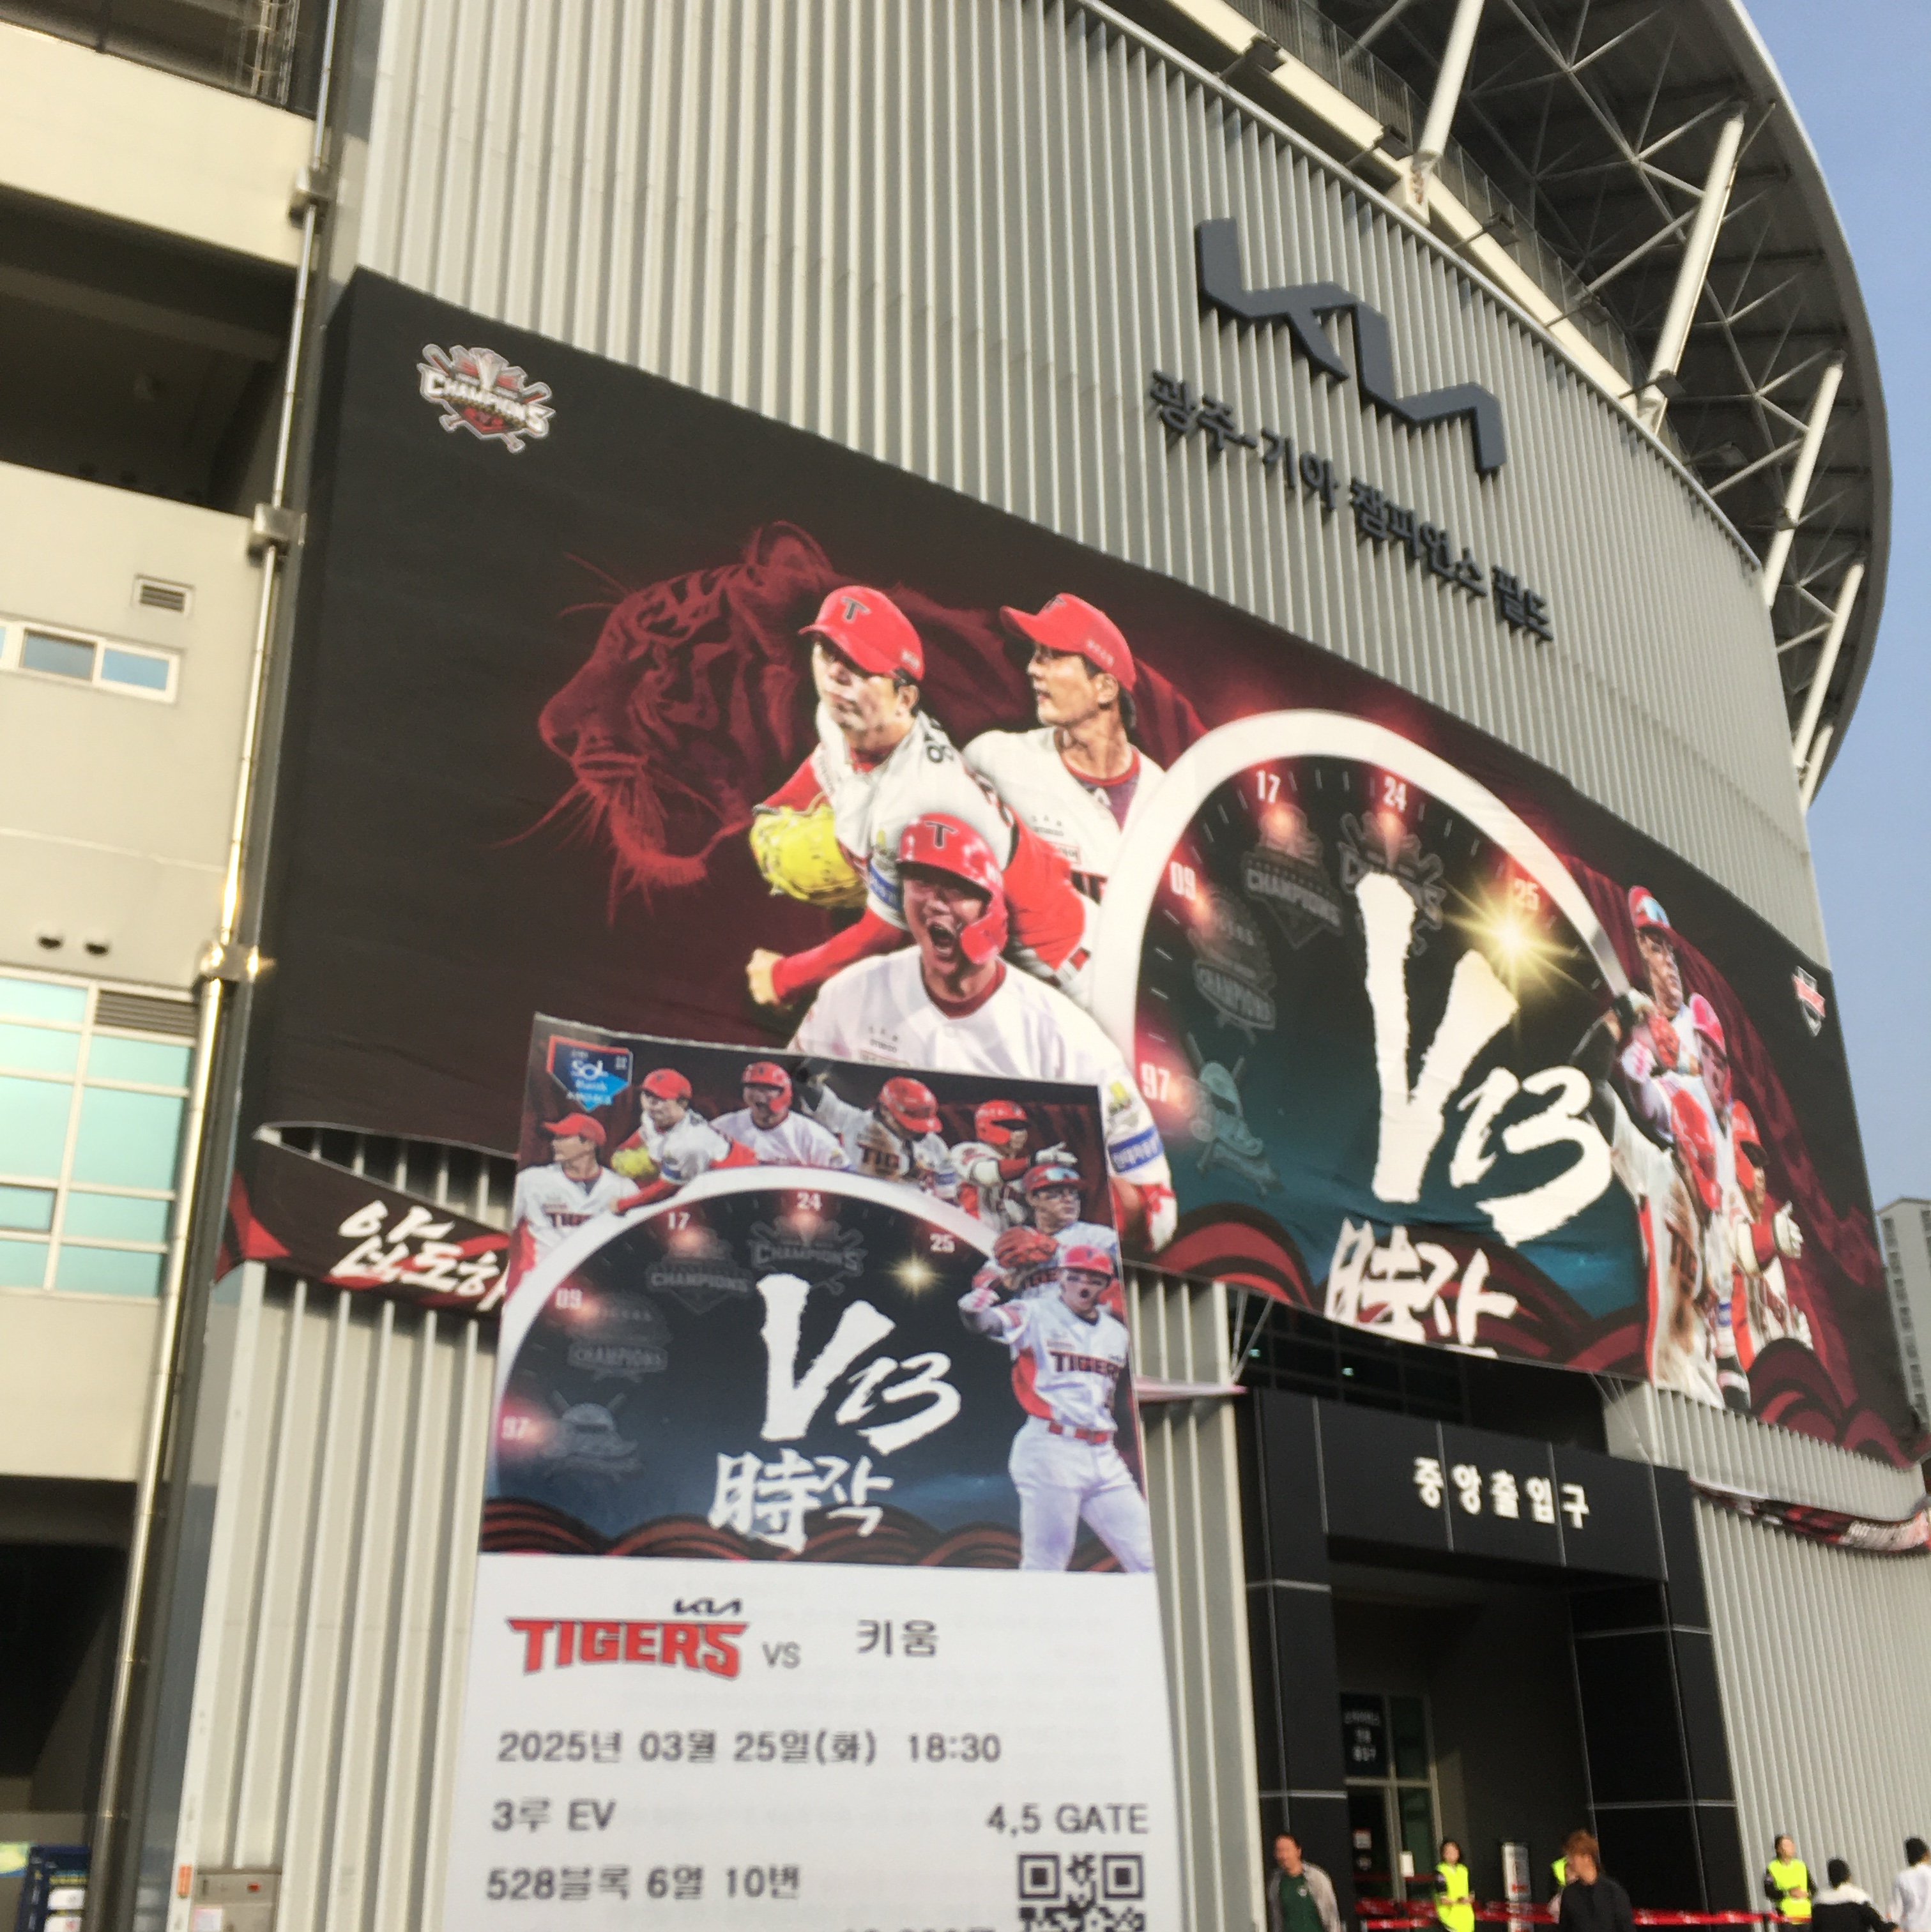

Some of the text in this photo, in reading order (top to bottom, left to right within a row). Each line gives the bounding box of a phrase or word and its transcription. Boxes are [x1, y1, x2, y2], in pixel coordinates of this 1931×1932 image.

[418, 365, 554, 434] CHAMPIONS
[1349, 476, 1487, 598] 챔피언스
[1491, 564, 1554, 642] 필드
[1256, 770, 1280, 803] 17
[1383, 775, 1408, 812] 24
[1170, 862, 1196, 901] 09
[1514, 878, 1541, 911] 25
[1355, 871, 1612, 1247] V13
[1141, 1062, 1170, 1102] 97
[797, 1192, 823, 1211] 24
[668, 1212, 691, 1230] 17
[930, 1234, 955, 1252] 25
[555, 1289, 582, 1309] 09
[756, 1274, 961, 1455] V13
[501, 1417, 530, 1440] 97
[708, 1449, 894, 1554] 時각
[505, 1617, 750, 1682] TIGERS
[856, 1619, 938, 1658] 키움
[497, 1728, 1002, 1765] 2025년 03월 25일(화) 18:30
[491, 1797, 616, 1832] 3루 EV
[986, 1802, 1149, 1837] 4,5 GATE
[486, 1863, 801, 1902] 528블록 6열 10번
